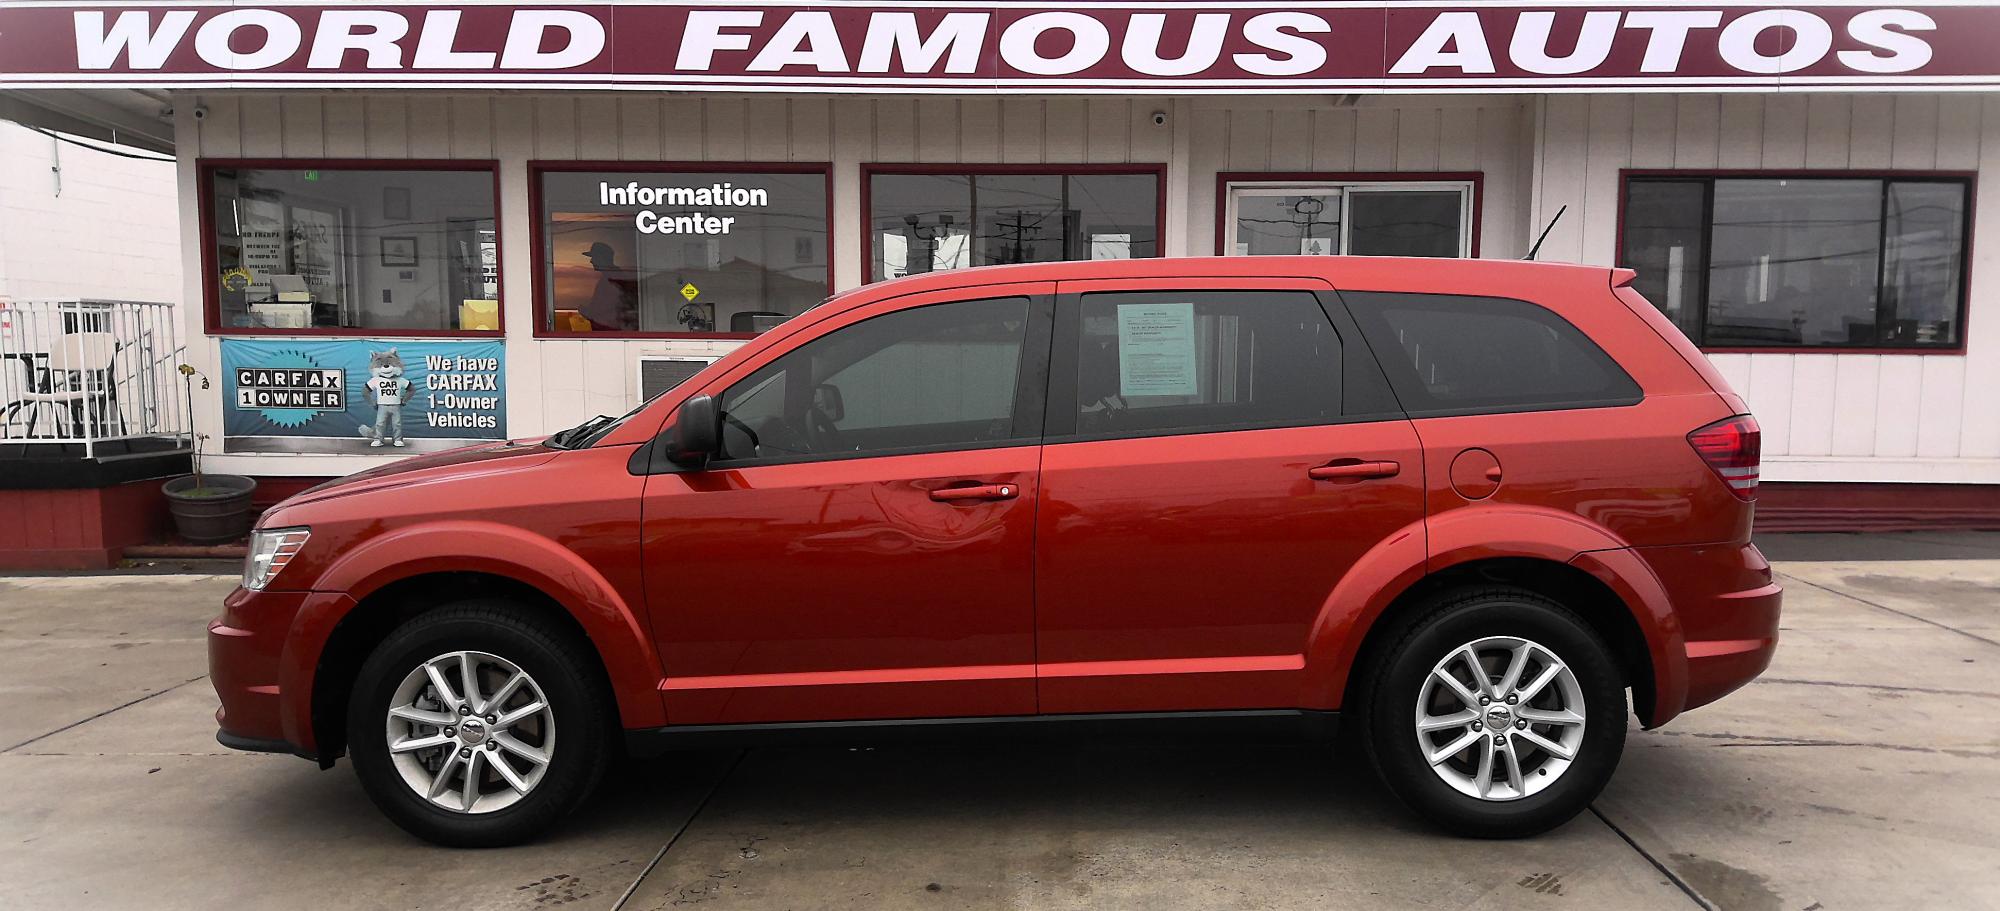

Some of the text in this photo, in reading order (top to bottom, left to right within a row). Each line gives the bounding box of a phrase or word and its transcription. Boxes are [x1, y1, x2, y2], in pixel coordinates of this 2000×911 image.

[73, 8, 1937, 76] WORLD FAMOUS AUTOS
[600, 182, 768, 206] Information
[635, 210, 735, 234] Center
[426, 355, 498, 372] We have
[240, 371, 339, 389] CARFAX
[379, 381, 398, 389] CAR
[426, 373, 497, 391] CARFAX
[380, 388, 398, 397] FOX
[427, 393, 498, 410] 1-Owner
[427, 411, 497, 428] Vehicles
